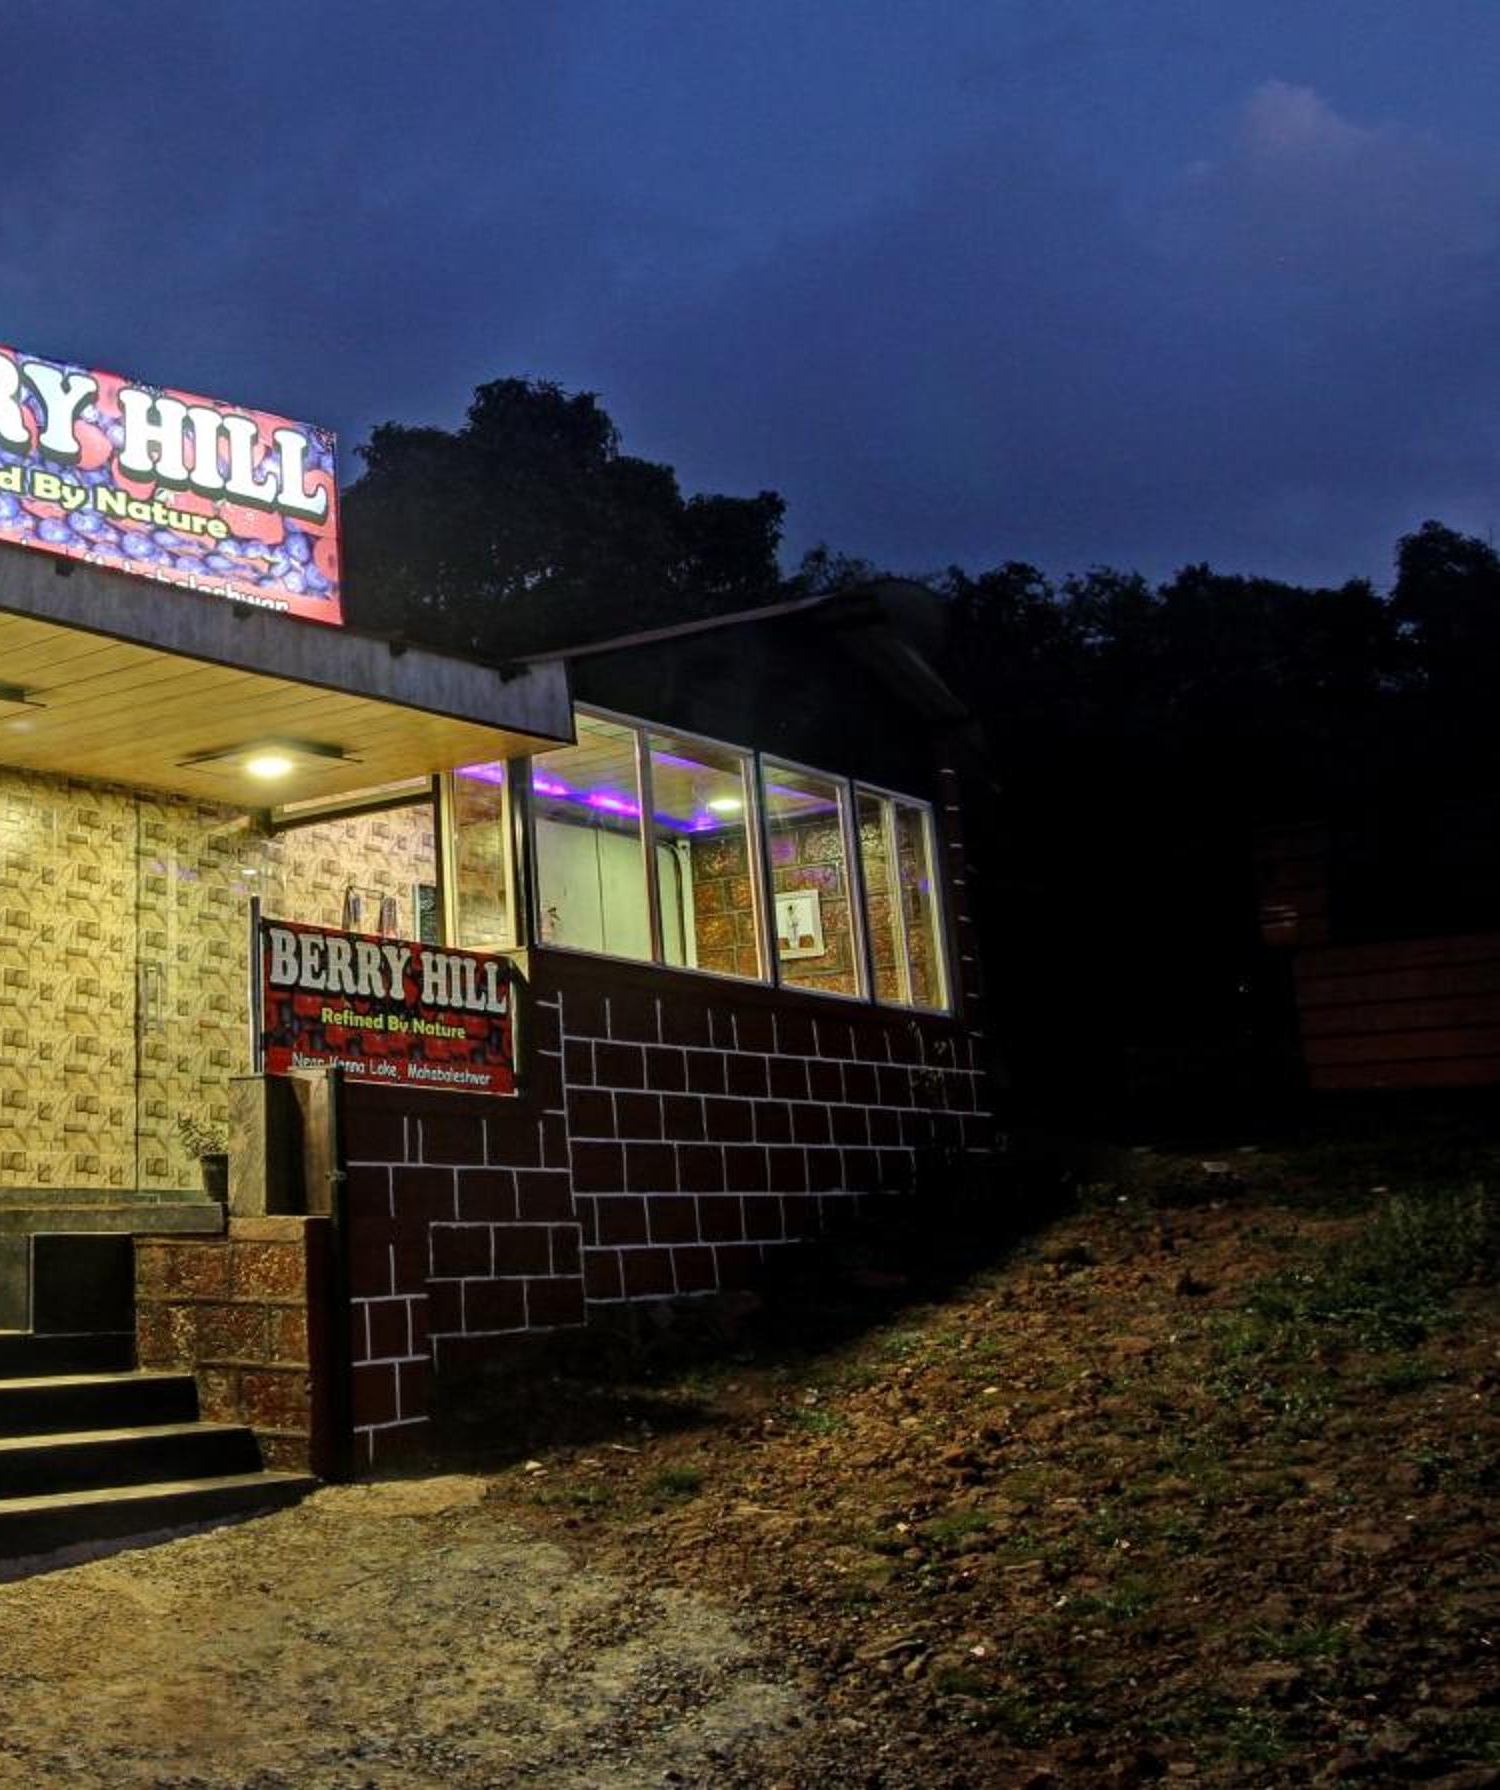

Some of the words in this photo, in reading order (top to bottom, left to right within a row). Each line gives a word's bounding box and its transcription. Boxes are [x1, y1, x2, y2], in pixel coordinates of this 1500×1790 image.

[119, 386, 328, 518] HILL
[32, 471, 86, 510] By
[96, 484, 228, 540] Nature
[269, 927, 411, 1000] BERRY
[420, 950, 507, 1013] HILL
[321, 1007, 383, 1031] Refined
[387, 1015, 409, 1033] By
[412, 1018, 466, 1039] Nature
